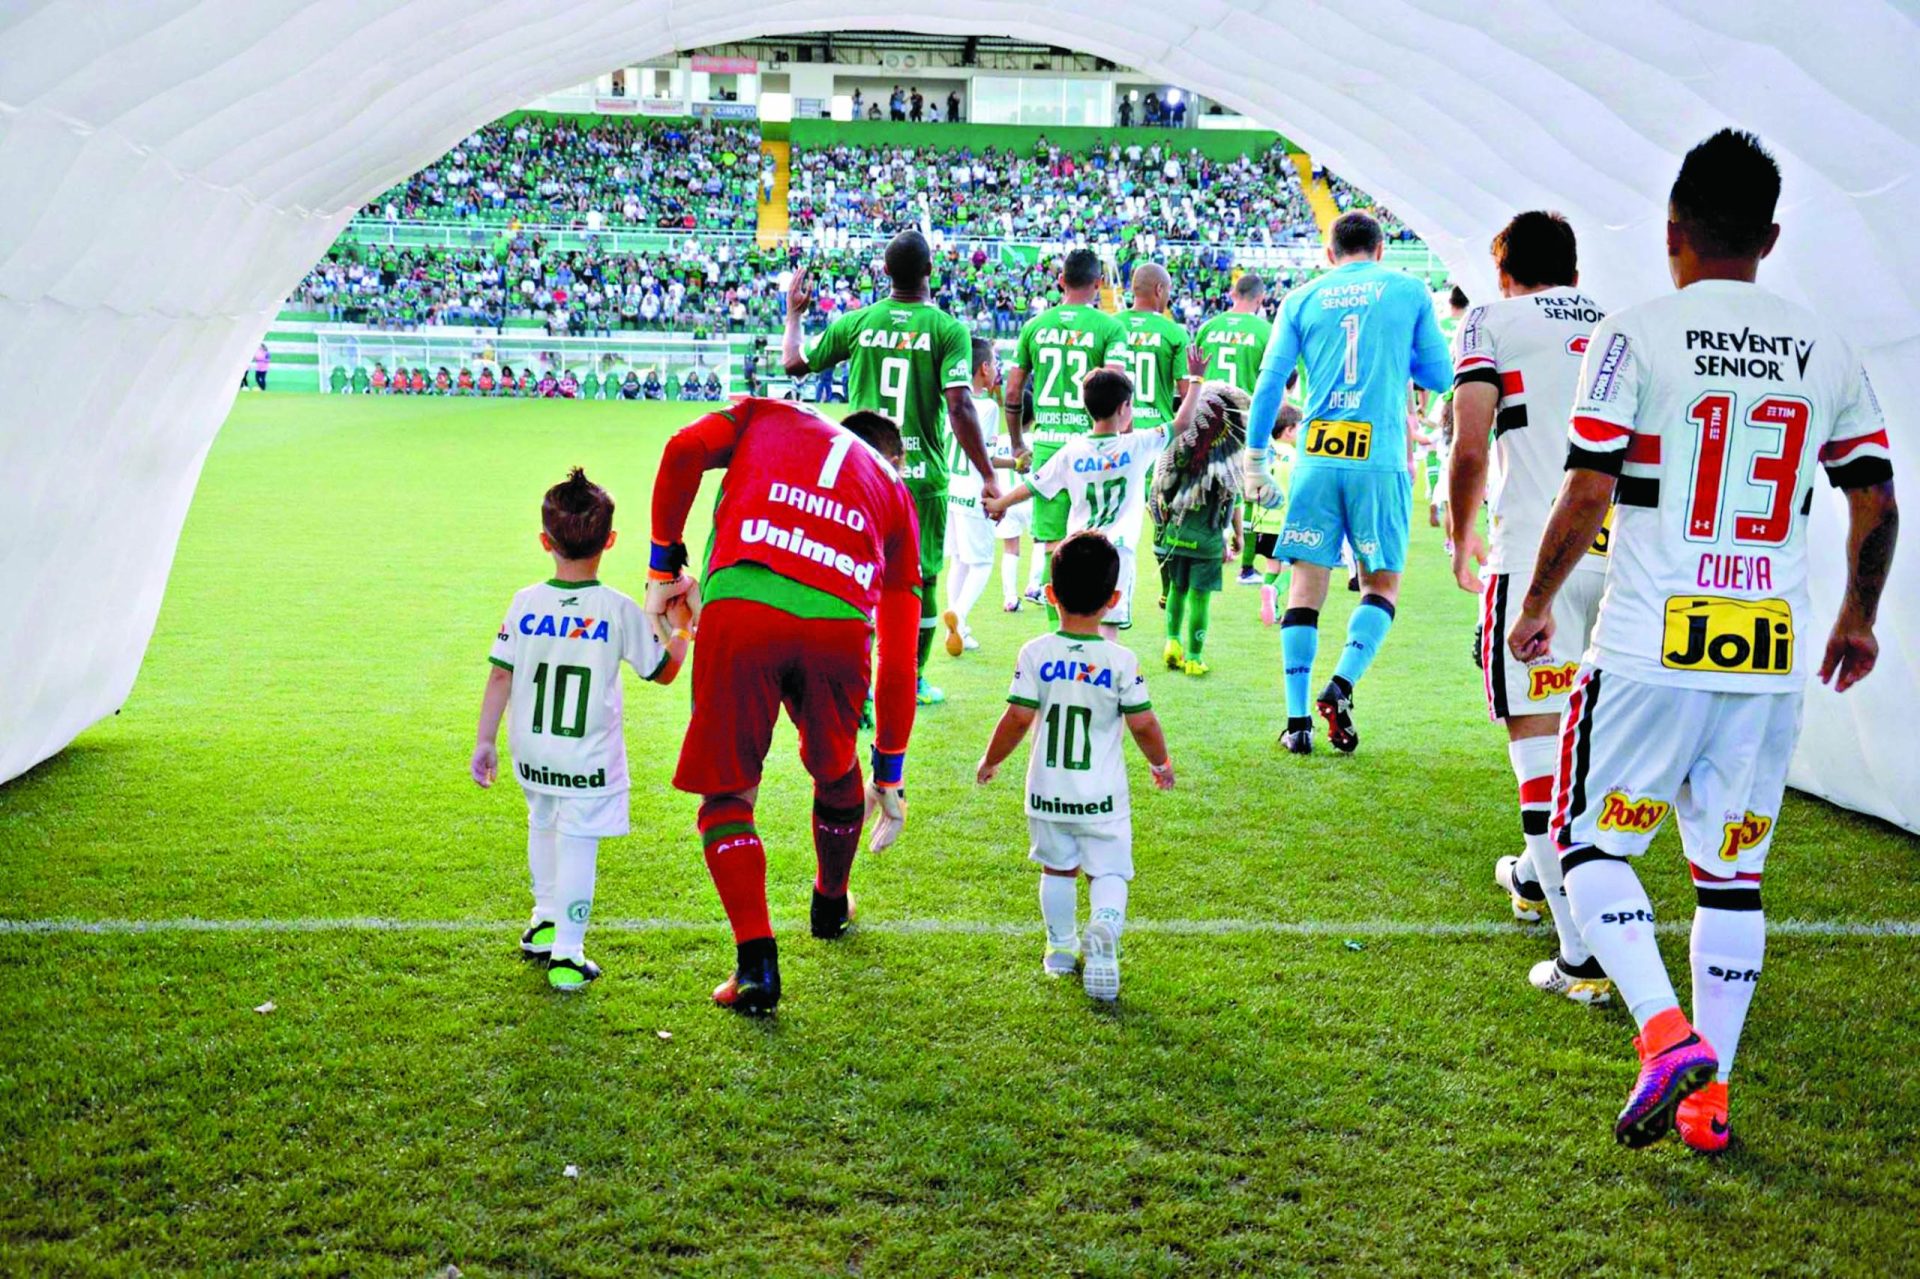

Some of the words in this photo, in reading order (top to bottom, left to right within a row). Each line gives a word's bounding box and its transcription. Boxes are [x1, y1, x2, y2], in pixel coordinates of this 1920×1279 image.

[1317, 283, 1374, 299] PREVENT
[1321, 296, 1370, 310] SENIOR
[858, 328, 931, 351] CAIXA
[1035, 327, 1094, 348] CAIXA
[1206, 330, 1255, 346] CAIXA
[1340, 313, 1360, 385] 1
[1686, 327, 1793, 355] PREVENT
[1037, 347, 1088, 409] 23
[1217, 346, 1237, 386] 5
[1694, 355, 1784, 381] SENIOR
[879, 356, 910, 430] 9
[1035, 411, 1061, 424] LUCAS
[1062, 414, 1089, 427] GOMES
[1778, 407, 1795, 419] TIM
[1306, 423, 1367, 458] Joli
[816, 434, 853, 489] 1
[1074, 451, 1131, 473] CAIXA
[1684, 390, 1815, 548] 13
[768, 482, 865, 533] DANILO
[1085, 476, 1127, 530] 10
[740, 518, 875, 591] Unimed
[1697, 553, 1772, 591] CUEVA
[519, 614, 609, 643] CAIXA
[1666, 602, 1790, 670] Joli
[1040, 660, 1112, 688] CAIXA
[1533, 666, 1577, 696] Pot
[532, 662, 591, 738] 10
[1046, 703, 1092, 770] 10
[519, 762, 606, 788] Unimed
[1030, 793, 1113, 815] Unimed
[1600, 797, 1664, 829] Poty
